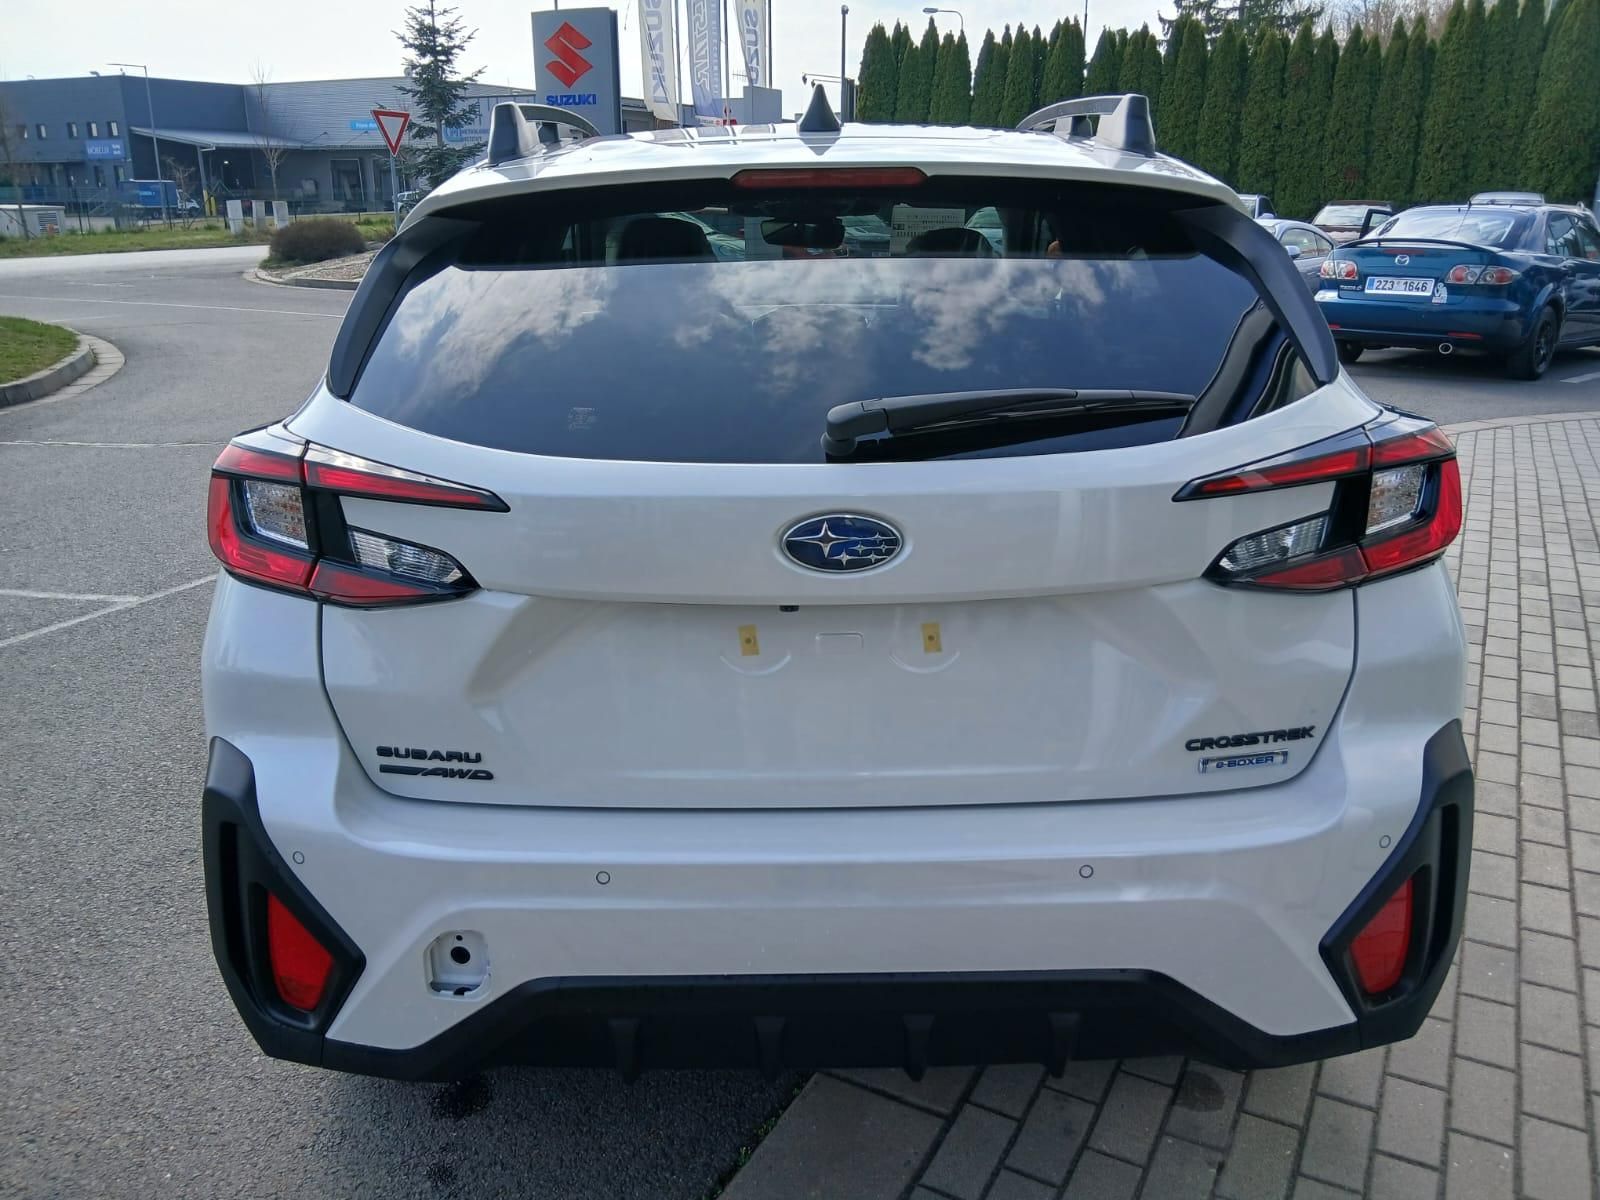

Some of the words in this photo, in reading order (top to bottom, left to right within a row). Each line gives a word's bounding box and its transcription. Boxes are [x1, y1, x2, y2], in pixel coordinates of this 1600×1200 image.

[546, 94, 597, 106] SUZUKI
[1375, 279, 1395, 291] 2Z3
[1402, 281, 1428, 292] 1646
[1185, 725, 1316, 752] CROSSTREK
[376, 745, 482, 763] SUBARU
[1216, 755, 1275, 769] e-BOXER
[421, 766, 494, 780] AWD
